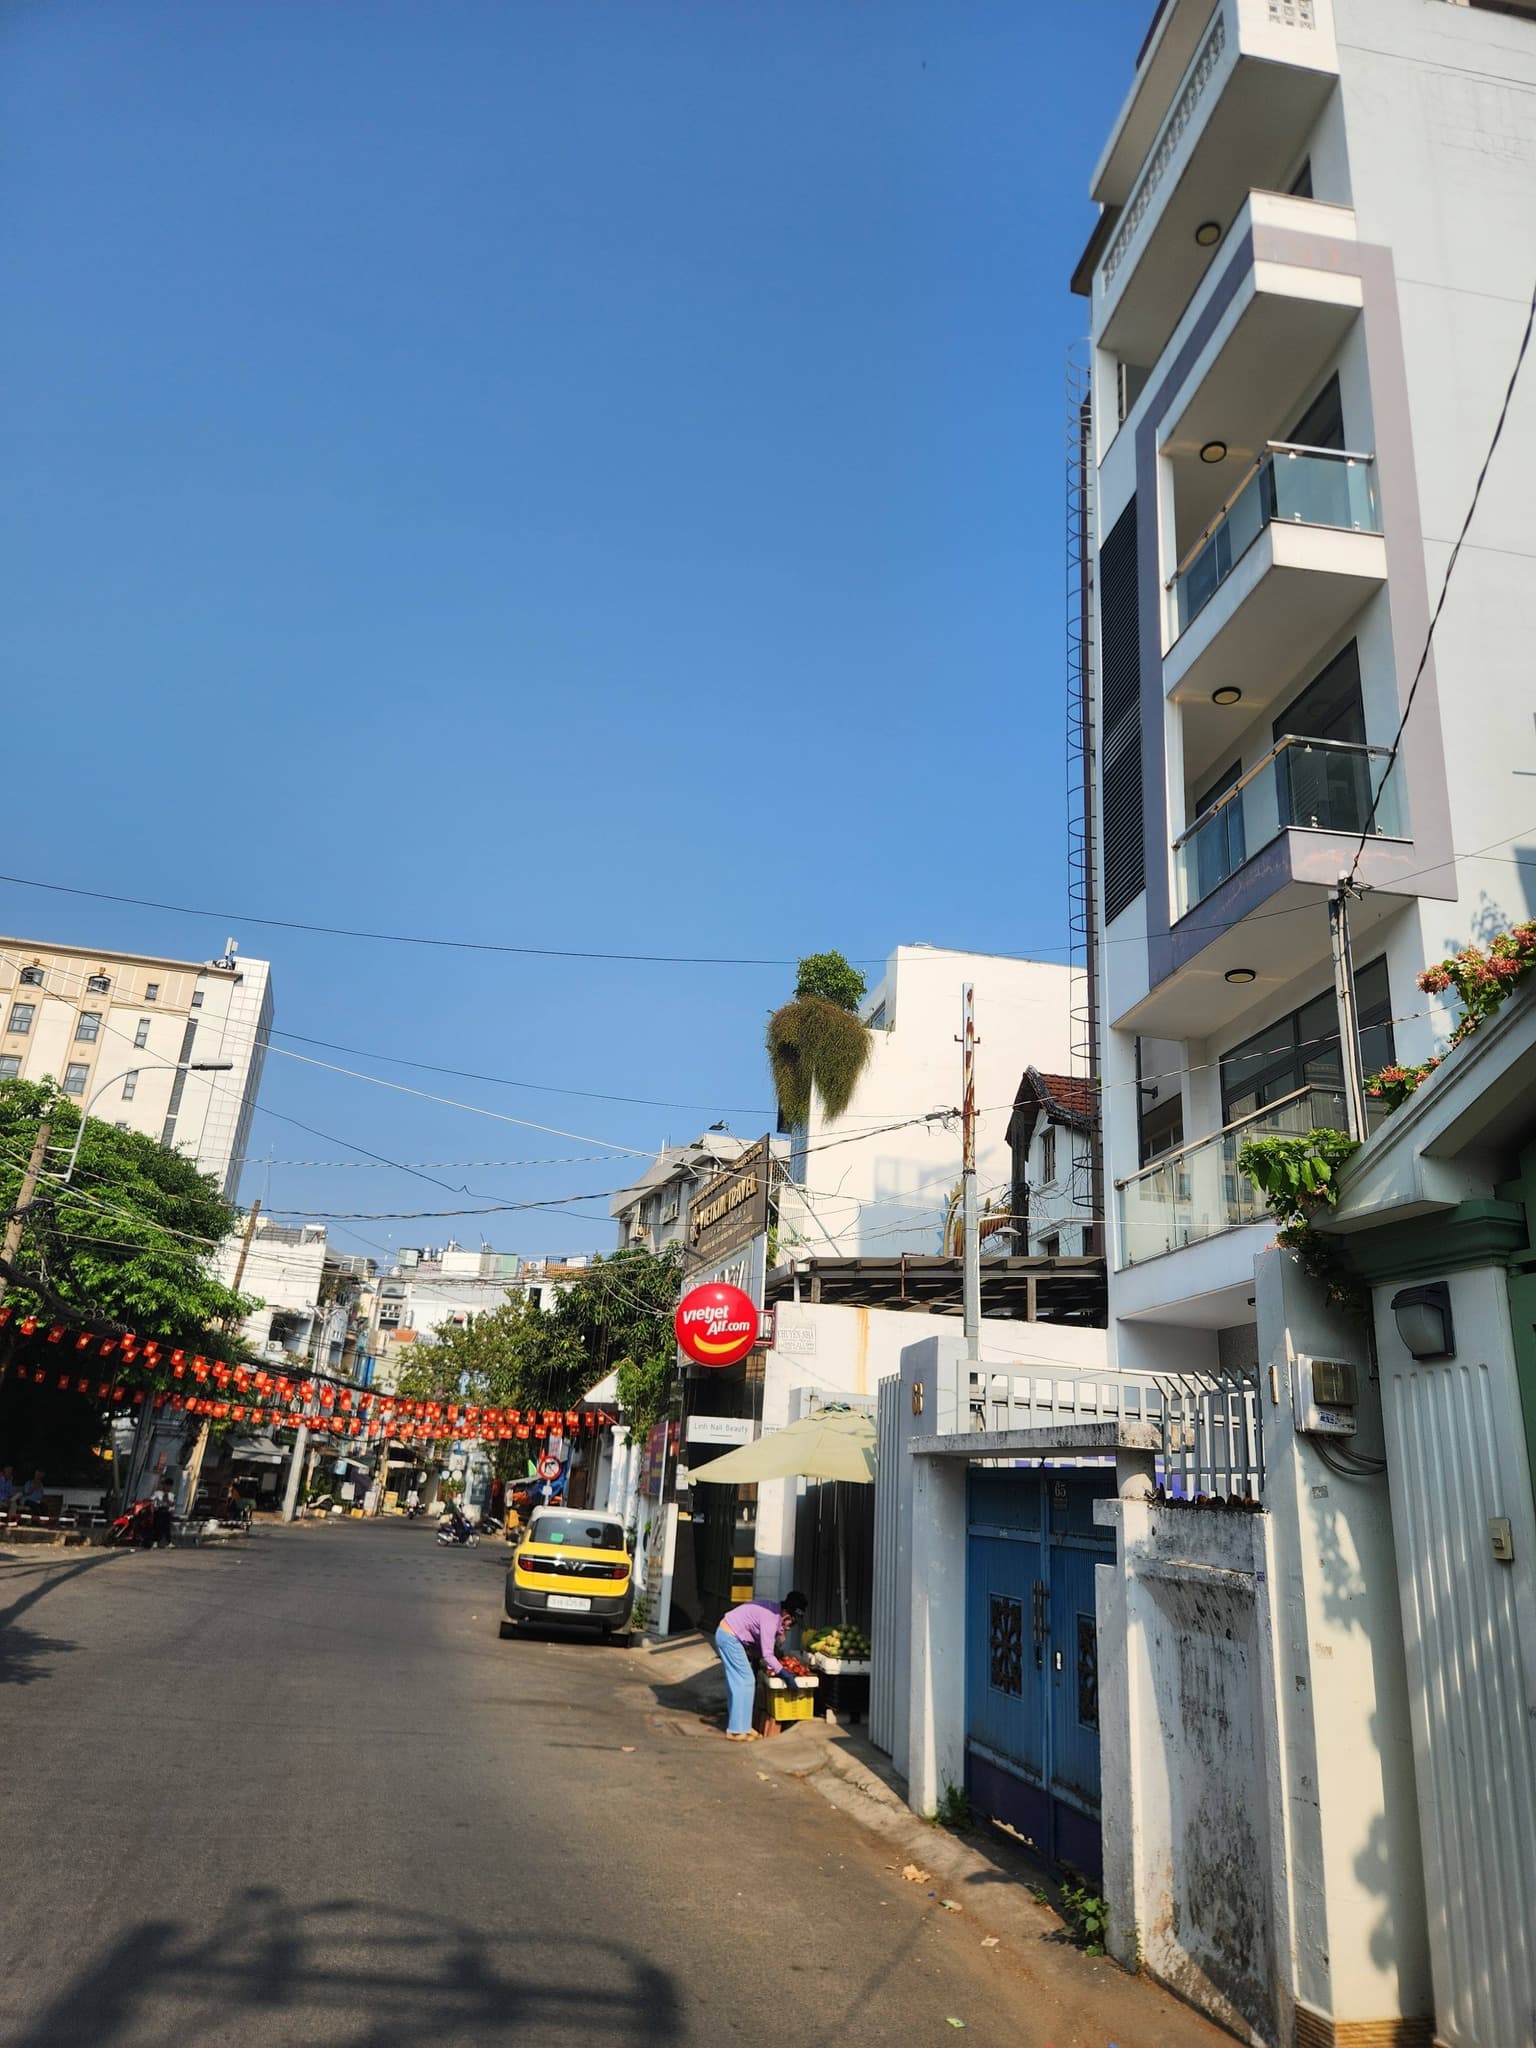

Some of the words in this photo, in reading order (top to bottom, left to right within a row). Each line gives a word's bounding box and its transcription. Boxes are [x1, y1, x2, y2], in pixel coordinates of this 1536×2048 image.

[728, 1171, 758, 1211] TRAVEL
[706, 1319, 750, 1336] Air.com
[710, 1423, 723, 1431] Nail
[725, 1424, 749, 1435] Beauty
[1054, 1480, 1067, 1498] 65
